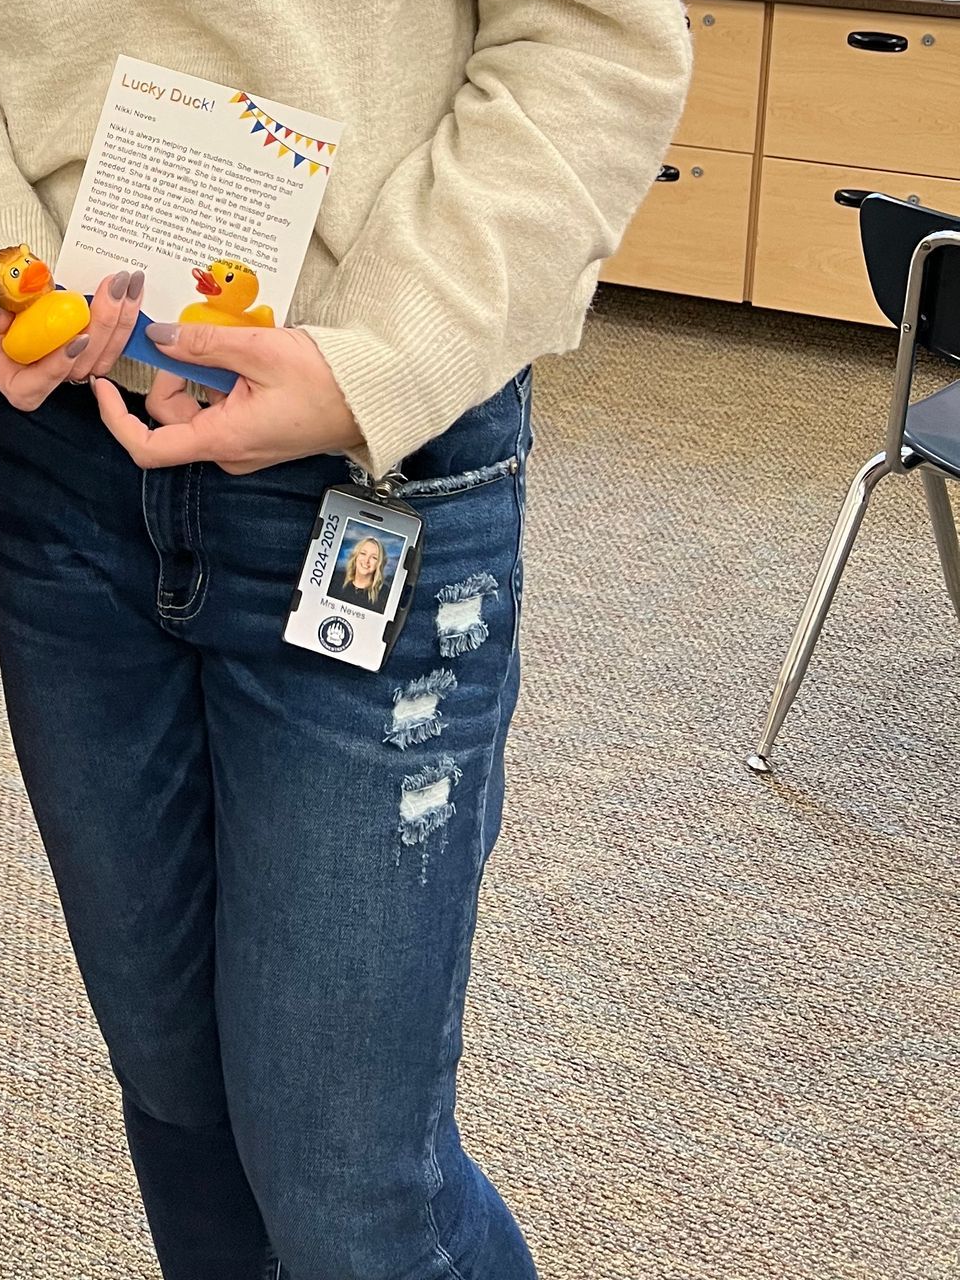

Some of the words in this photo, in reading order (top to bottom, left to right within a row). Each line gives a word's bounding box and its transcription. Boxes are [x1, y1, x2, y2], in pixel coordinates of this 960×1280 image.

[115, 105, 133, 115] Nikki
[122, 74, 166, 100] Lucky
[170, 88, 216, 113] Duck!
[102, 152, 127, 164] around
[128, 160, 142, 168] and
[143, 163, 149, 171] is
[150, 167, 175, 179] always
[177, 175, 199, 187] willing
[200, 181, 208, 189] to
[208, 184, 225, 195] help
[226, 191, 248, 202] where
[250, 198, 263, 207] she
[264, 202, 271, 210] is
[104, 141, 117, 150] her
[117, 146, 148, 160] students
[149, 156, 161, 164] are
[194, 169, 210, 180] She
[219, 177, 234, 187] kind
[244, 186, 278, 201] everyone
[107, 132, 114, 140] to
[115, 136, 136, 146] make
[137, 142, 153, 152] sure
[154, 147, 175, 159] things
[188, 159, 203, 167] well
[203, 162, 210, 170] in
[211, 165, 224, 174] her
[225, 170, 262, 186] classroom
[263, 183, 278, 191] and
[279, 186, 294, 196] that
[110, 123, 127, 133] Nikki
[136, 132, 161, 144] always
[162, 139, 188, 154] helping
[189, 148, 202, 156] her
[237, 162, 252, 173] She
[254, 169, 274, 180] works
[286, 179, 304, 189] hard
[91, 186, 107, 197] from
[109, 193, 120, 202] the
[121, 198, 140, 208] good
[141, 204, 154, 212] she
[155, 208, 173, 218] does
[175, 215, 189, 223] with
[190, 218, 217, 234] helping
[218, 228, 249, 243] students
[250, 238, 279, 253] improve
[94, 178, 123, 193] blessing
[124, 187, 132, 195] to
[133, 190, 153, 202] those
[162, 200, 172, 208] us
[173, 204, 199, 216] around
[216, 216, 228, 226] We
[229, 222, 241, 230] will
[252, 228, 277, 242] benefit
[97, 170, 116, 180] when
[117, 176, 130, 185] she
[132, 181, 151, 191] starts
[153, 186, 166, 196] this
[167, 192, 182, 201] new
[214, 207, 232, 217] even
[233, 213, 248, 222] that
[249, 217, 255, 225] is
[129, 169, 144, 179] She
[159, 180, 178, 190] great
[179, 186, 199, 196] asset
[200, 192, 215, 201] and
[228, 200, 238, 209] be
[239, 205, 266, 218] missed
[266, 214, 291, 227] greatly
[76, 241, 94, 252] From
[96, 247, 129, 264] Christena
[131, 259, 148, 270] Gray
[81, 225, 108, 238] working
[156, 247, 174, 258] Nikki
[83, 214, 94, 222] for
[94, 218, 107, 226] her
[142, 232, 158, 244] That
[159, 238, 165, 246] is
[167, 242, 184, 252] what
[185, 248, 199, 257] she
[207, 254, 234, 269] looking
[243, 268, 258, 276] and
[88, 196, 119, 210] behavior
[120, 207, 134, 216] and
[135, 211, 150, 220] that
[150, 216, 184, 232] increases
[186, 227, 202, 237] their
[203, 234, 224, 246] ability
[225, 240, 233, 248] to
[256, 250, 271, 260] She
[92, 207, 119, 220] teacher
[120, 216, 134, 226] that
[135, 221, 151, 232] truly
[152, 227, 172, 238] cares
[173, 234, 194, 245] about
[195, 240, 207, 249] the
[208, 244, 224, 256] long
[225, 250, 241, 260] term
[242, 257, 278, 273] outcomes
[310, 514, 339, 587] 2024-2025
[340, 605, 366, 620] Neves
